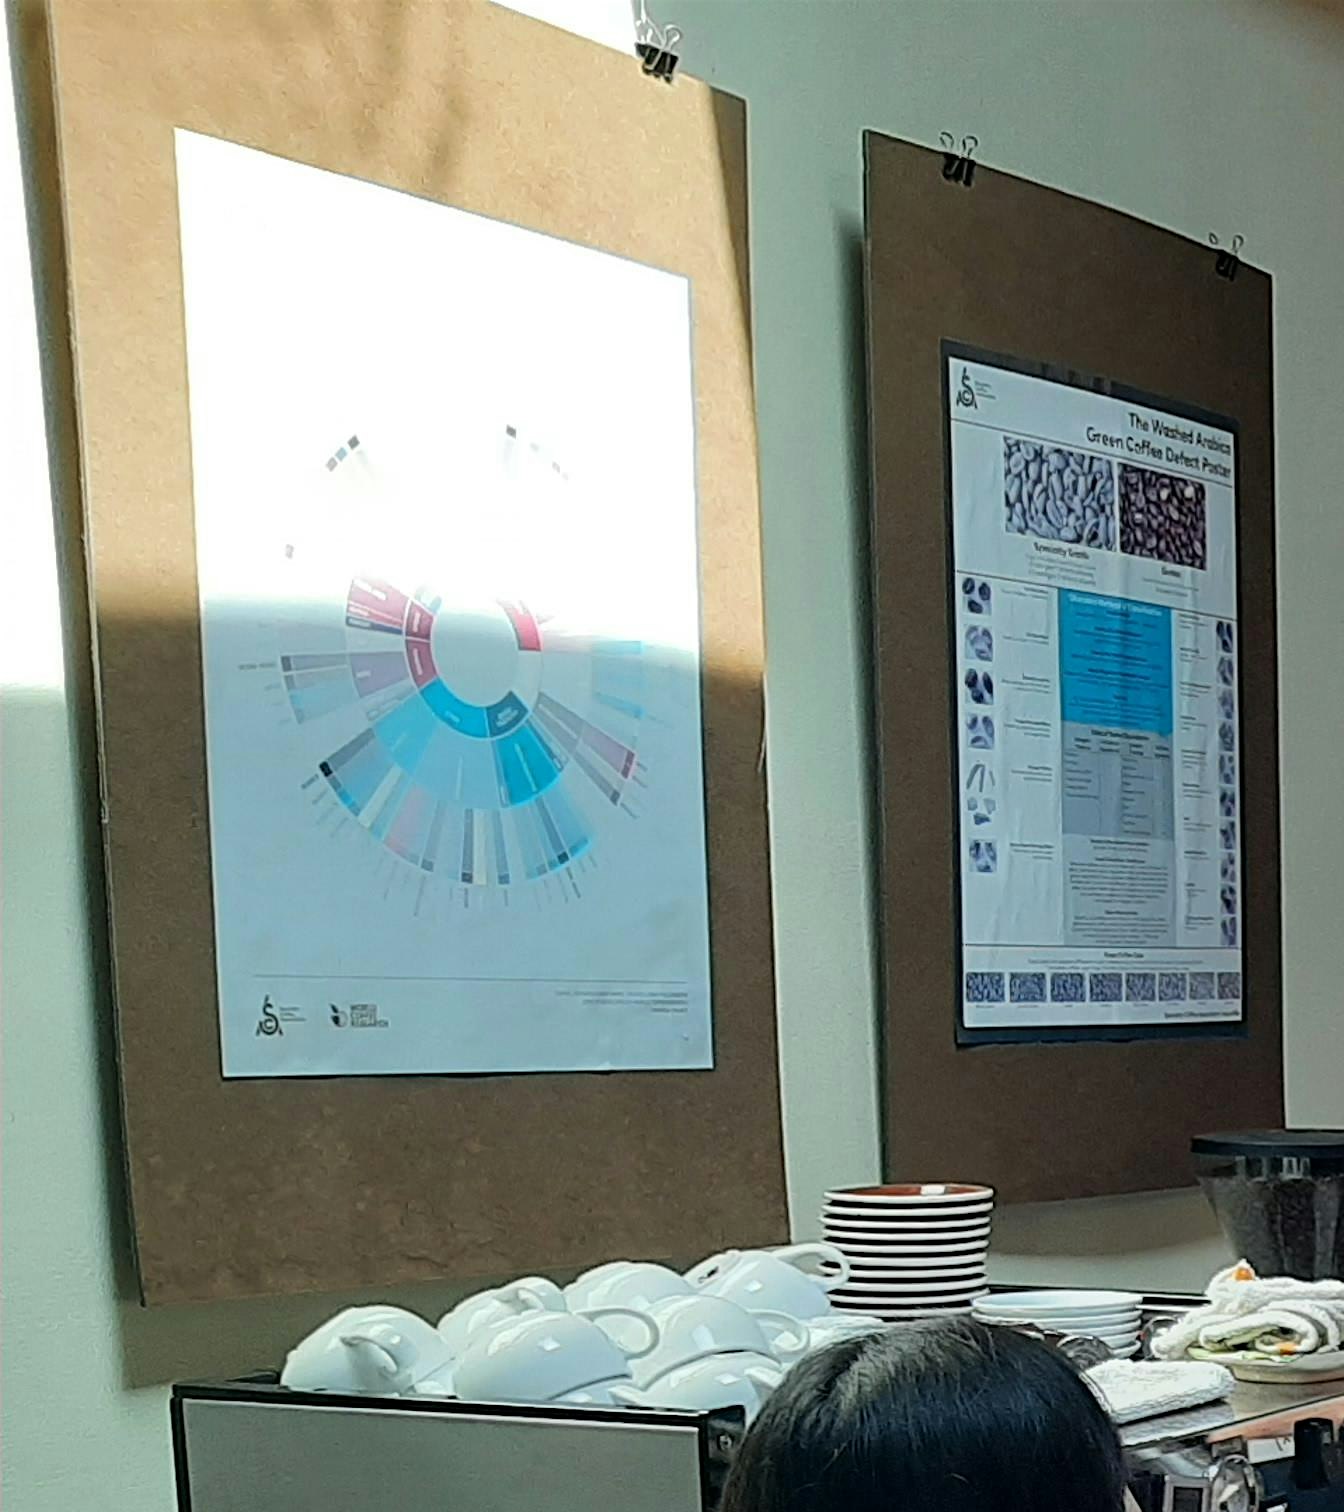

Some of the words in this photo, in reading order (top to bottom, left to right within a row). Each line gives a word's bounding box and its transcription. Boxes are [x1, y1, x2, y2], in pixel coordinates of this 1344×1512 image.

[1086, 426, 1123, 449] Green
[1126, 436, 1163, 460] Coffee
[1128, 412, 1149, 432] The
[1152, 419, 1193, 444] Washed
